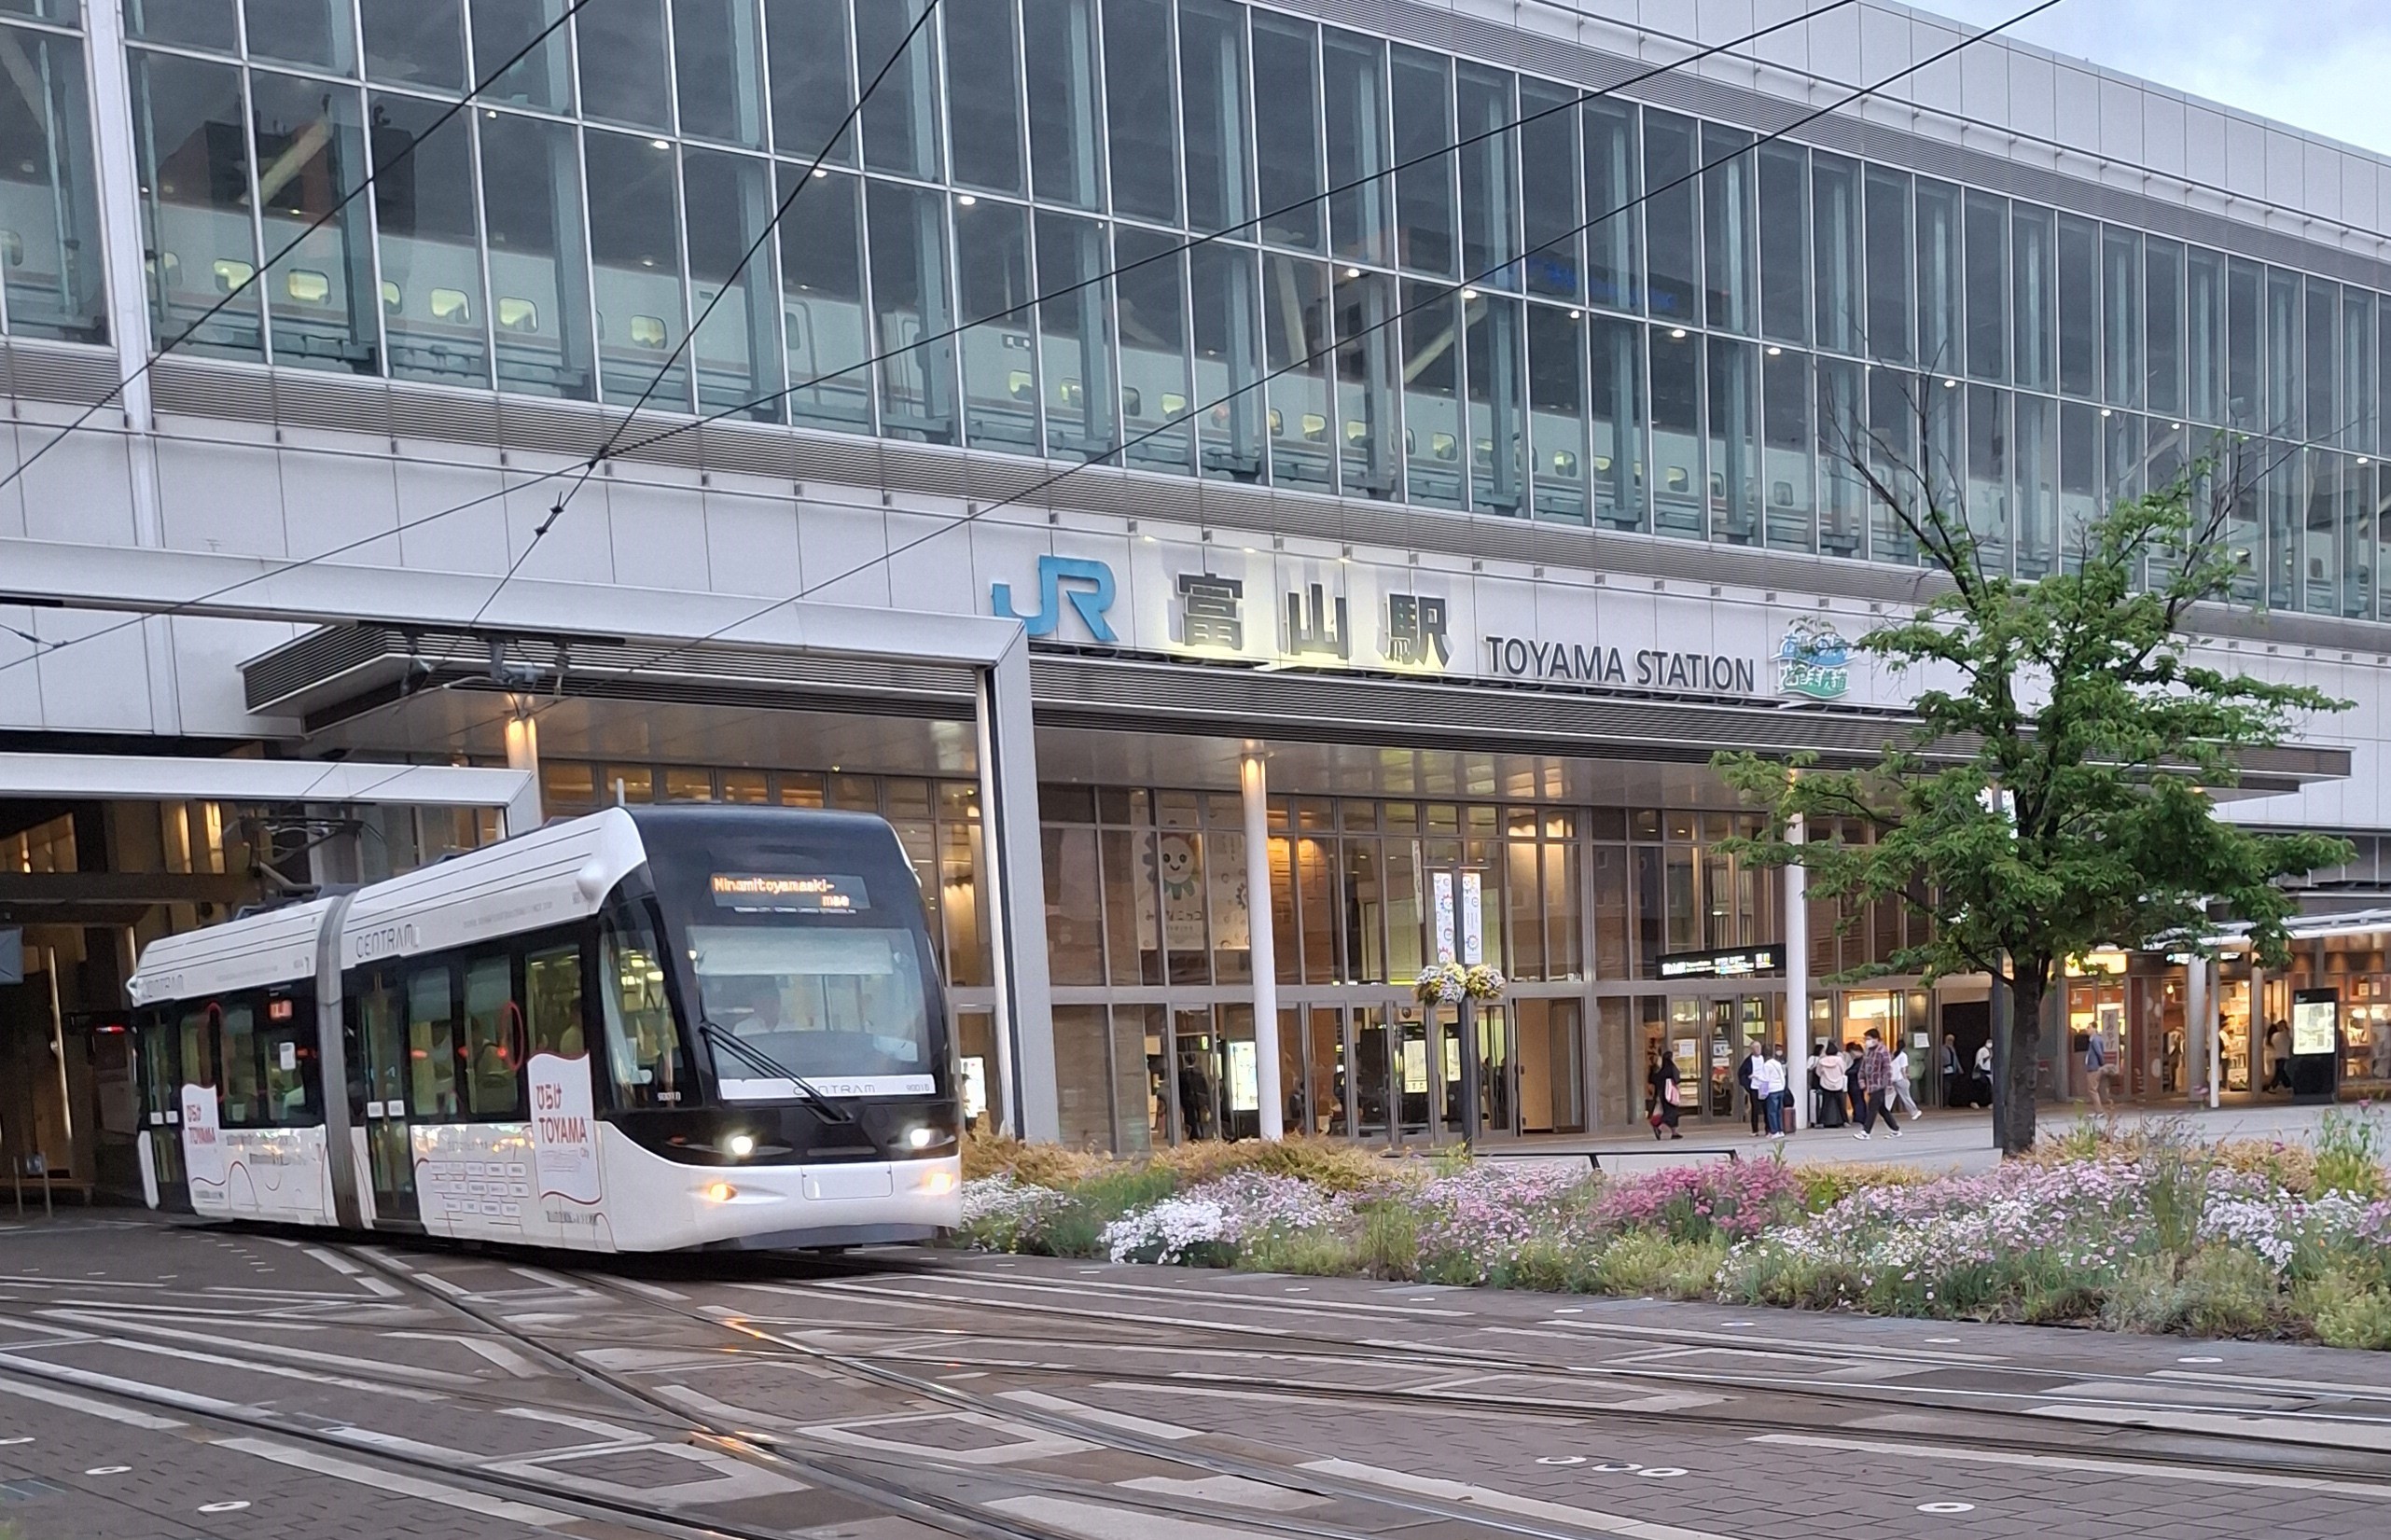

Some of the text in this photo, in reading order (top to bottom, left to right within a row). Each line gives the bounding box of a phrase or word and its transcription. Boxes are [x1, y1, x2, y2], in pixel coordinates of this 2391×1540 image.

[993, 555, 1119, 642] JR
[1177, 573, 1450, 670] 富山駅
[1485, 635, 1754, 693] TOYAMA STATION
[355, 923, 413, 959] CENTRAM
[535, 1083, 563, 1111] ひらけ
[792, 1084, 876, 1096] CNTRAM
[538, 1117, 589, 1145] TOYAMA
